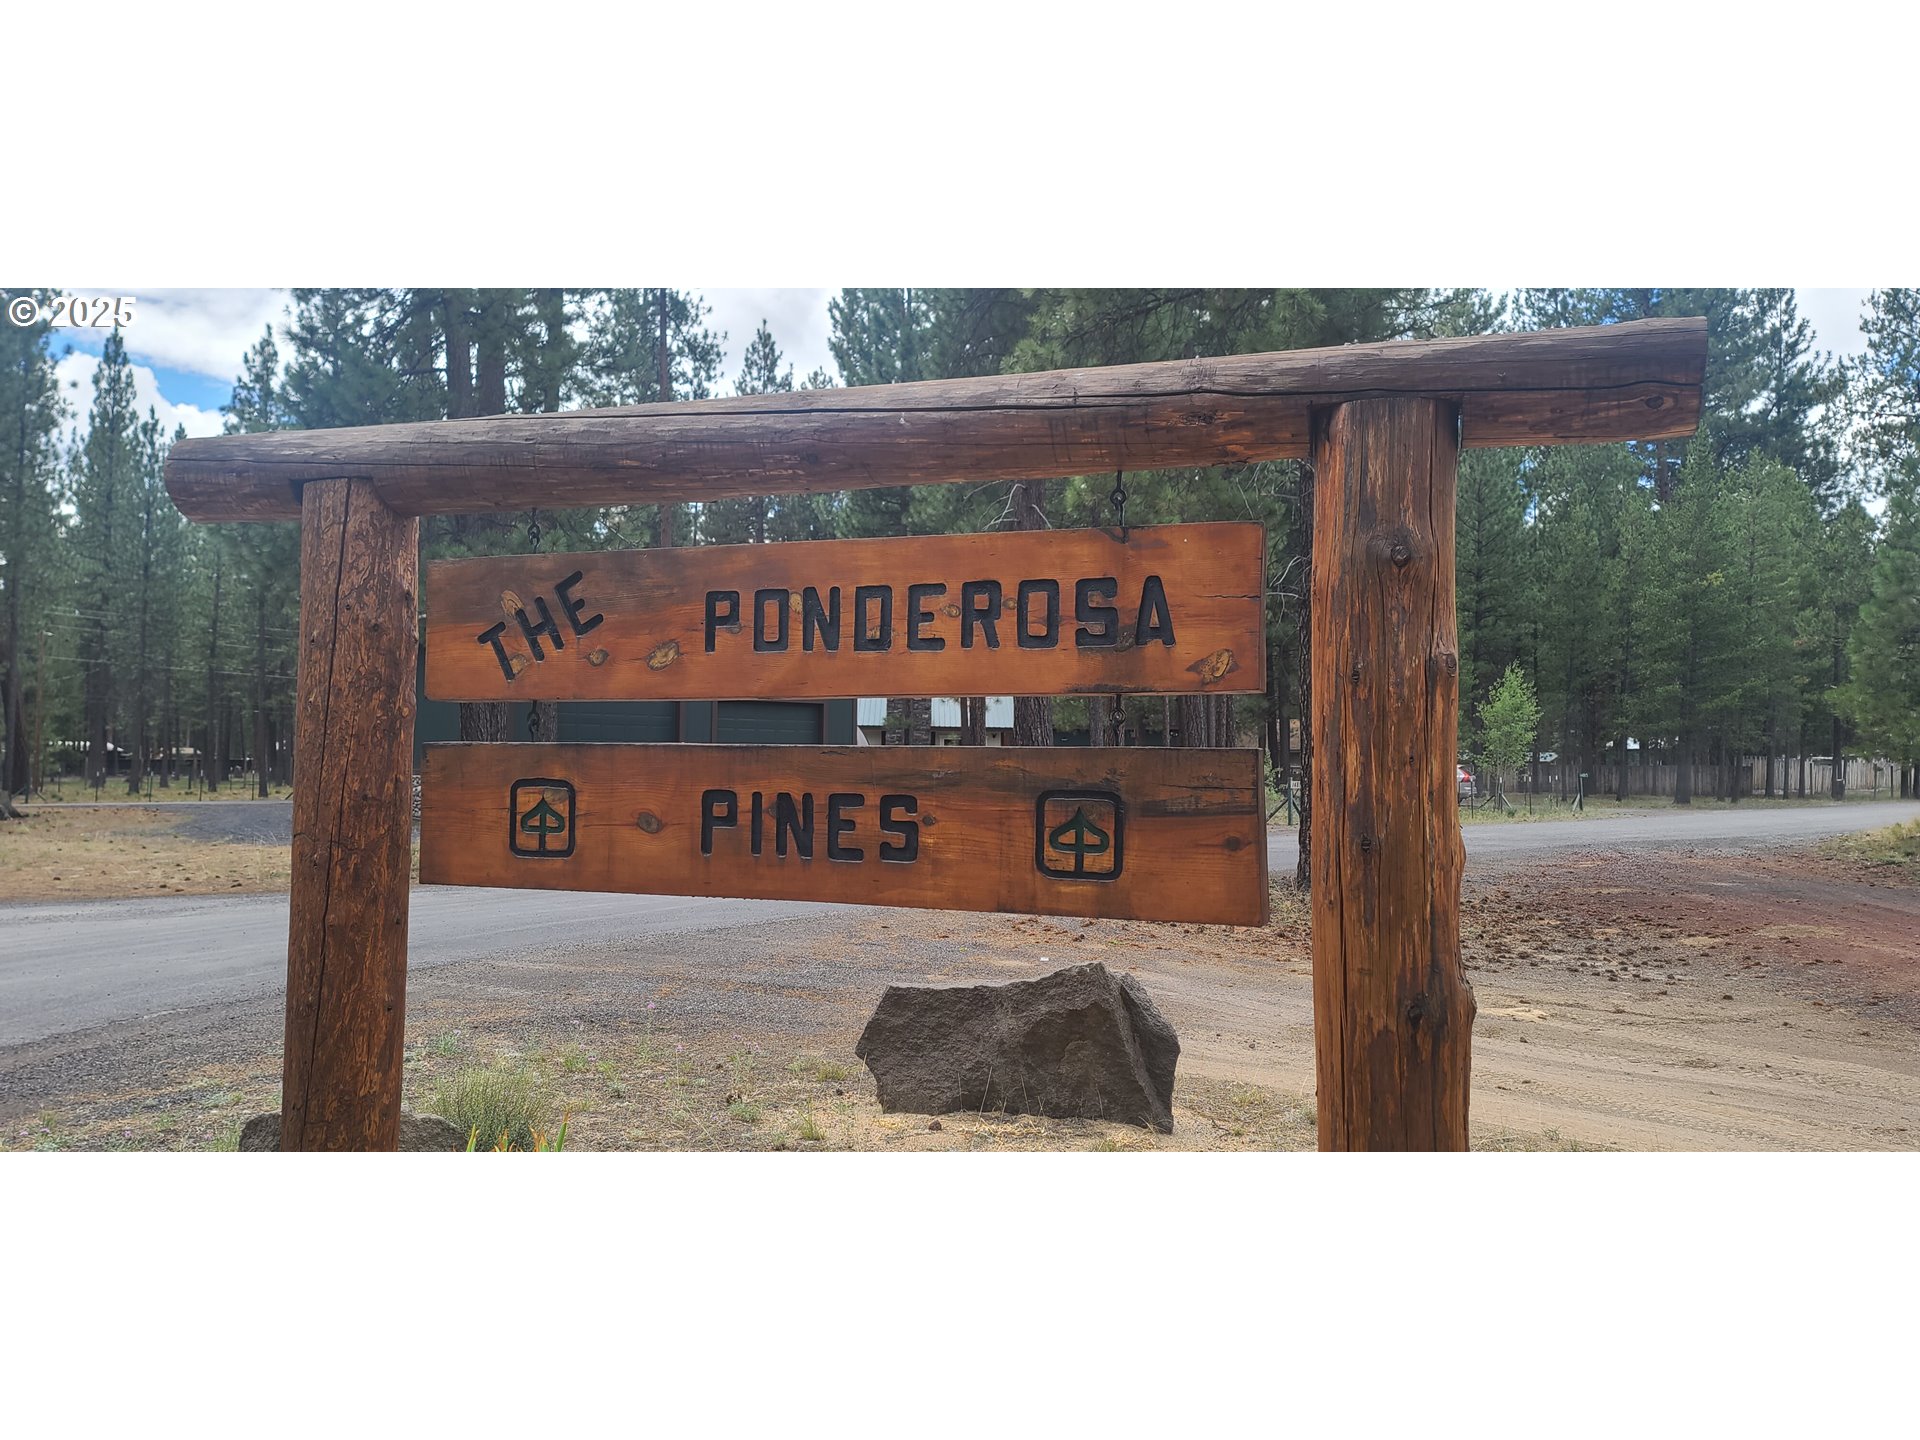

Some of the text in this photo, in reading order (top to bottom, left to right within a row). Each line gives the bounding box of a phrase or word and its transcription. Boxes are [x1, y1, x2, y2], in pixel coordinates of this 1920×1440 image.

[477, 570, 1176, 682] THE PONDEROSA
[700, 789, 919, 863] PINES
